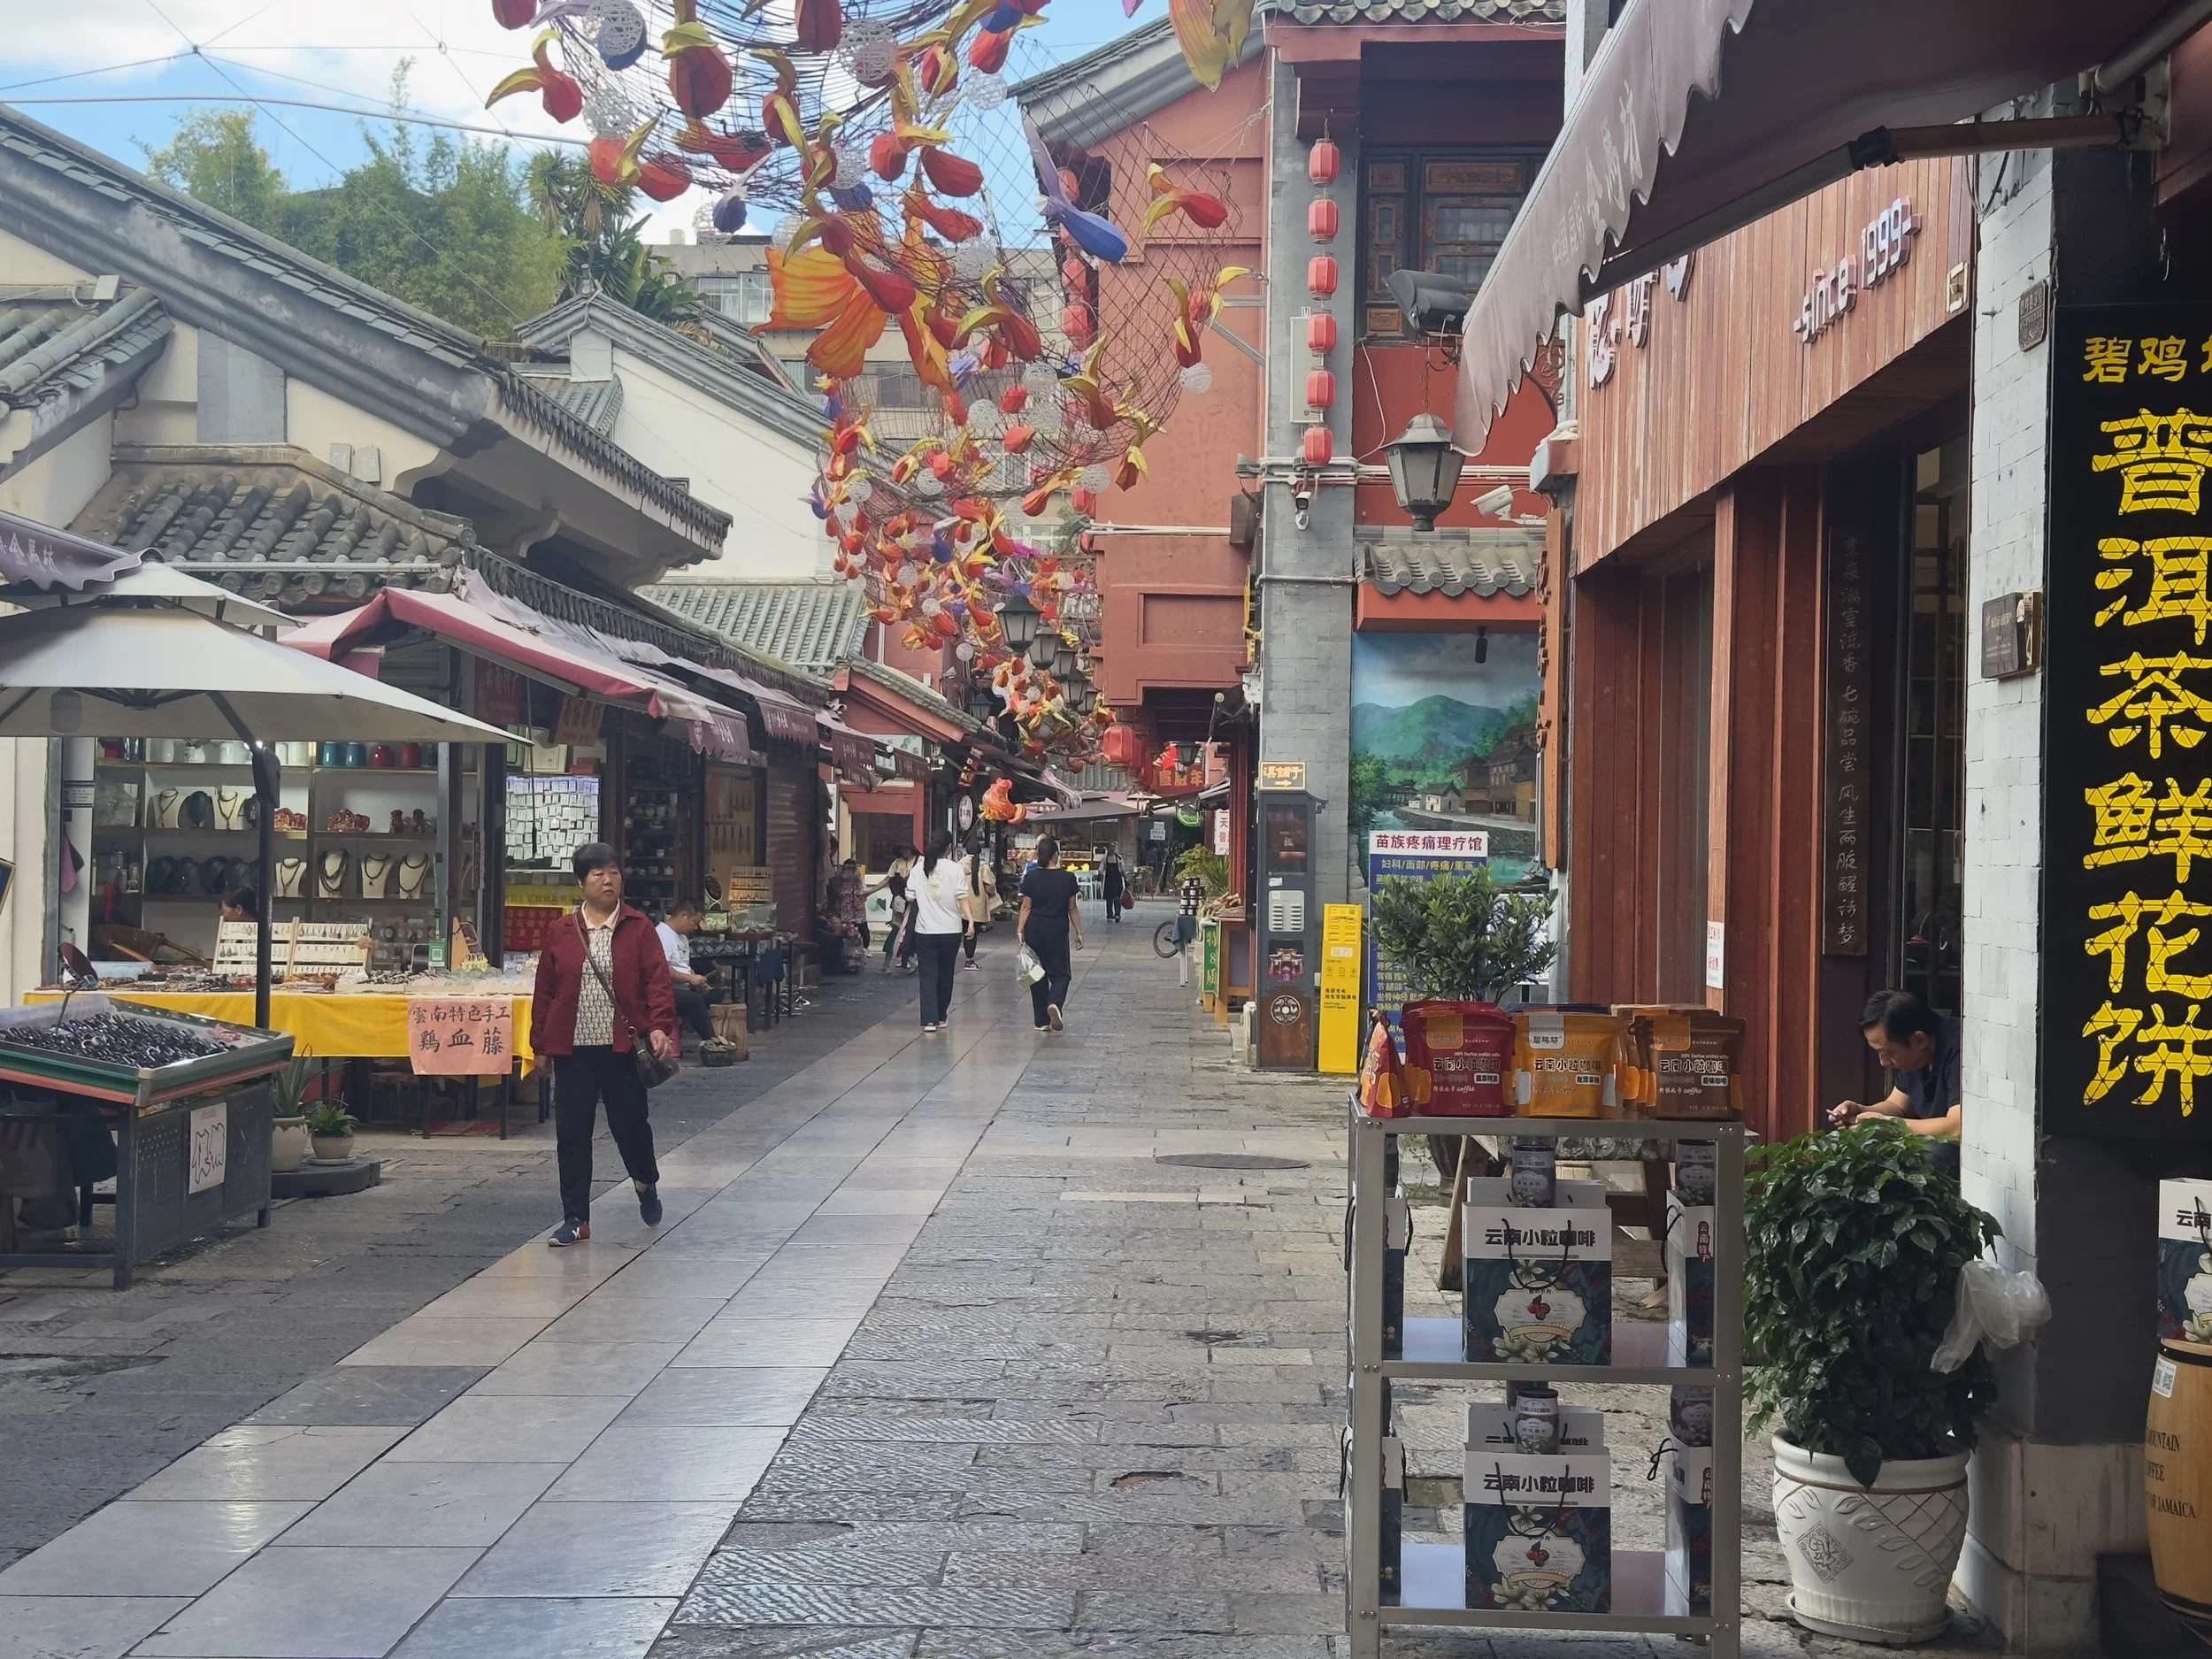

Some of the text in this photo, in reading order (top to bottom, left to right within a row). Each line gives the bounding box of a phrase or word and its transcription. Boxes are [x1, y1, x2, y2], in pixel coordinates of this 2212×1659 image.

[1375, 833, 1483, 851] 苗族疼痛理疗馆
[412, 1004, 511, 1025] 雲南特色手工
[1485, 1228, 1596, 1248] 云南小粒咖啡
[1483, 1473, 1595, 1494] 云南小粒咖啡
